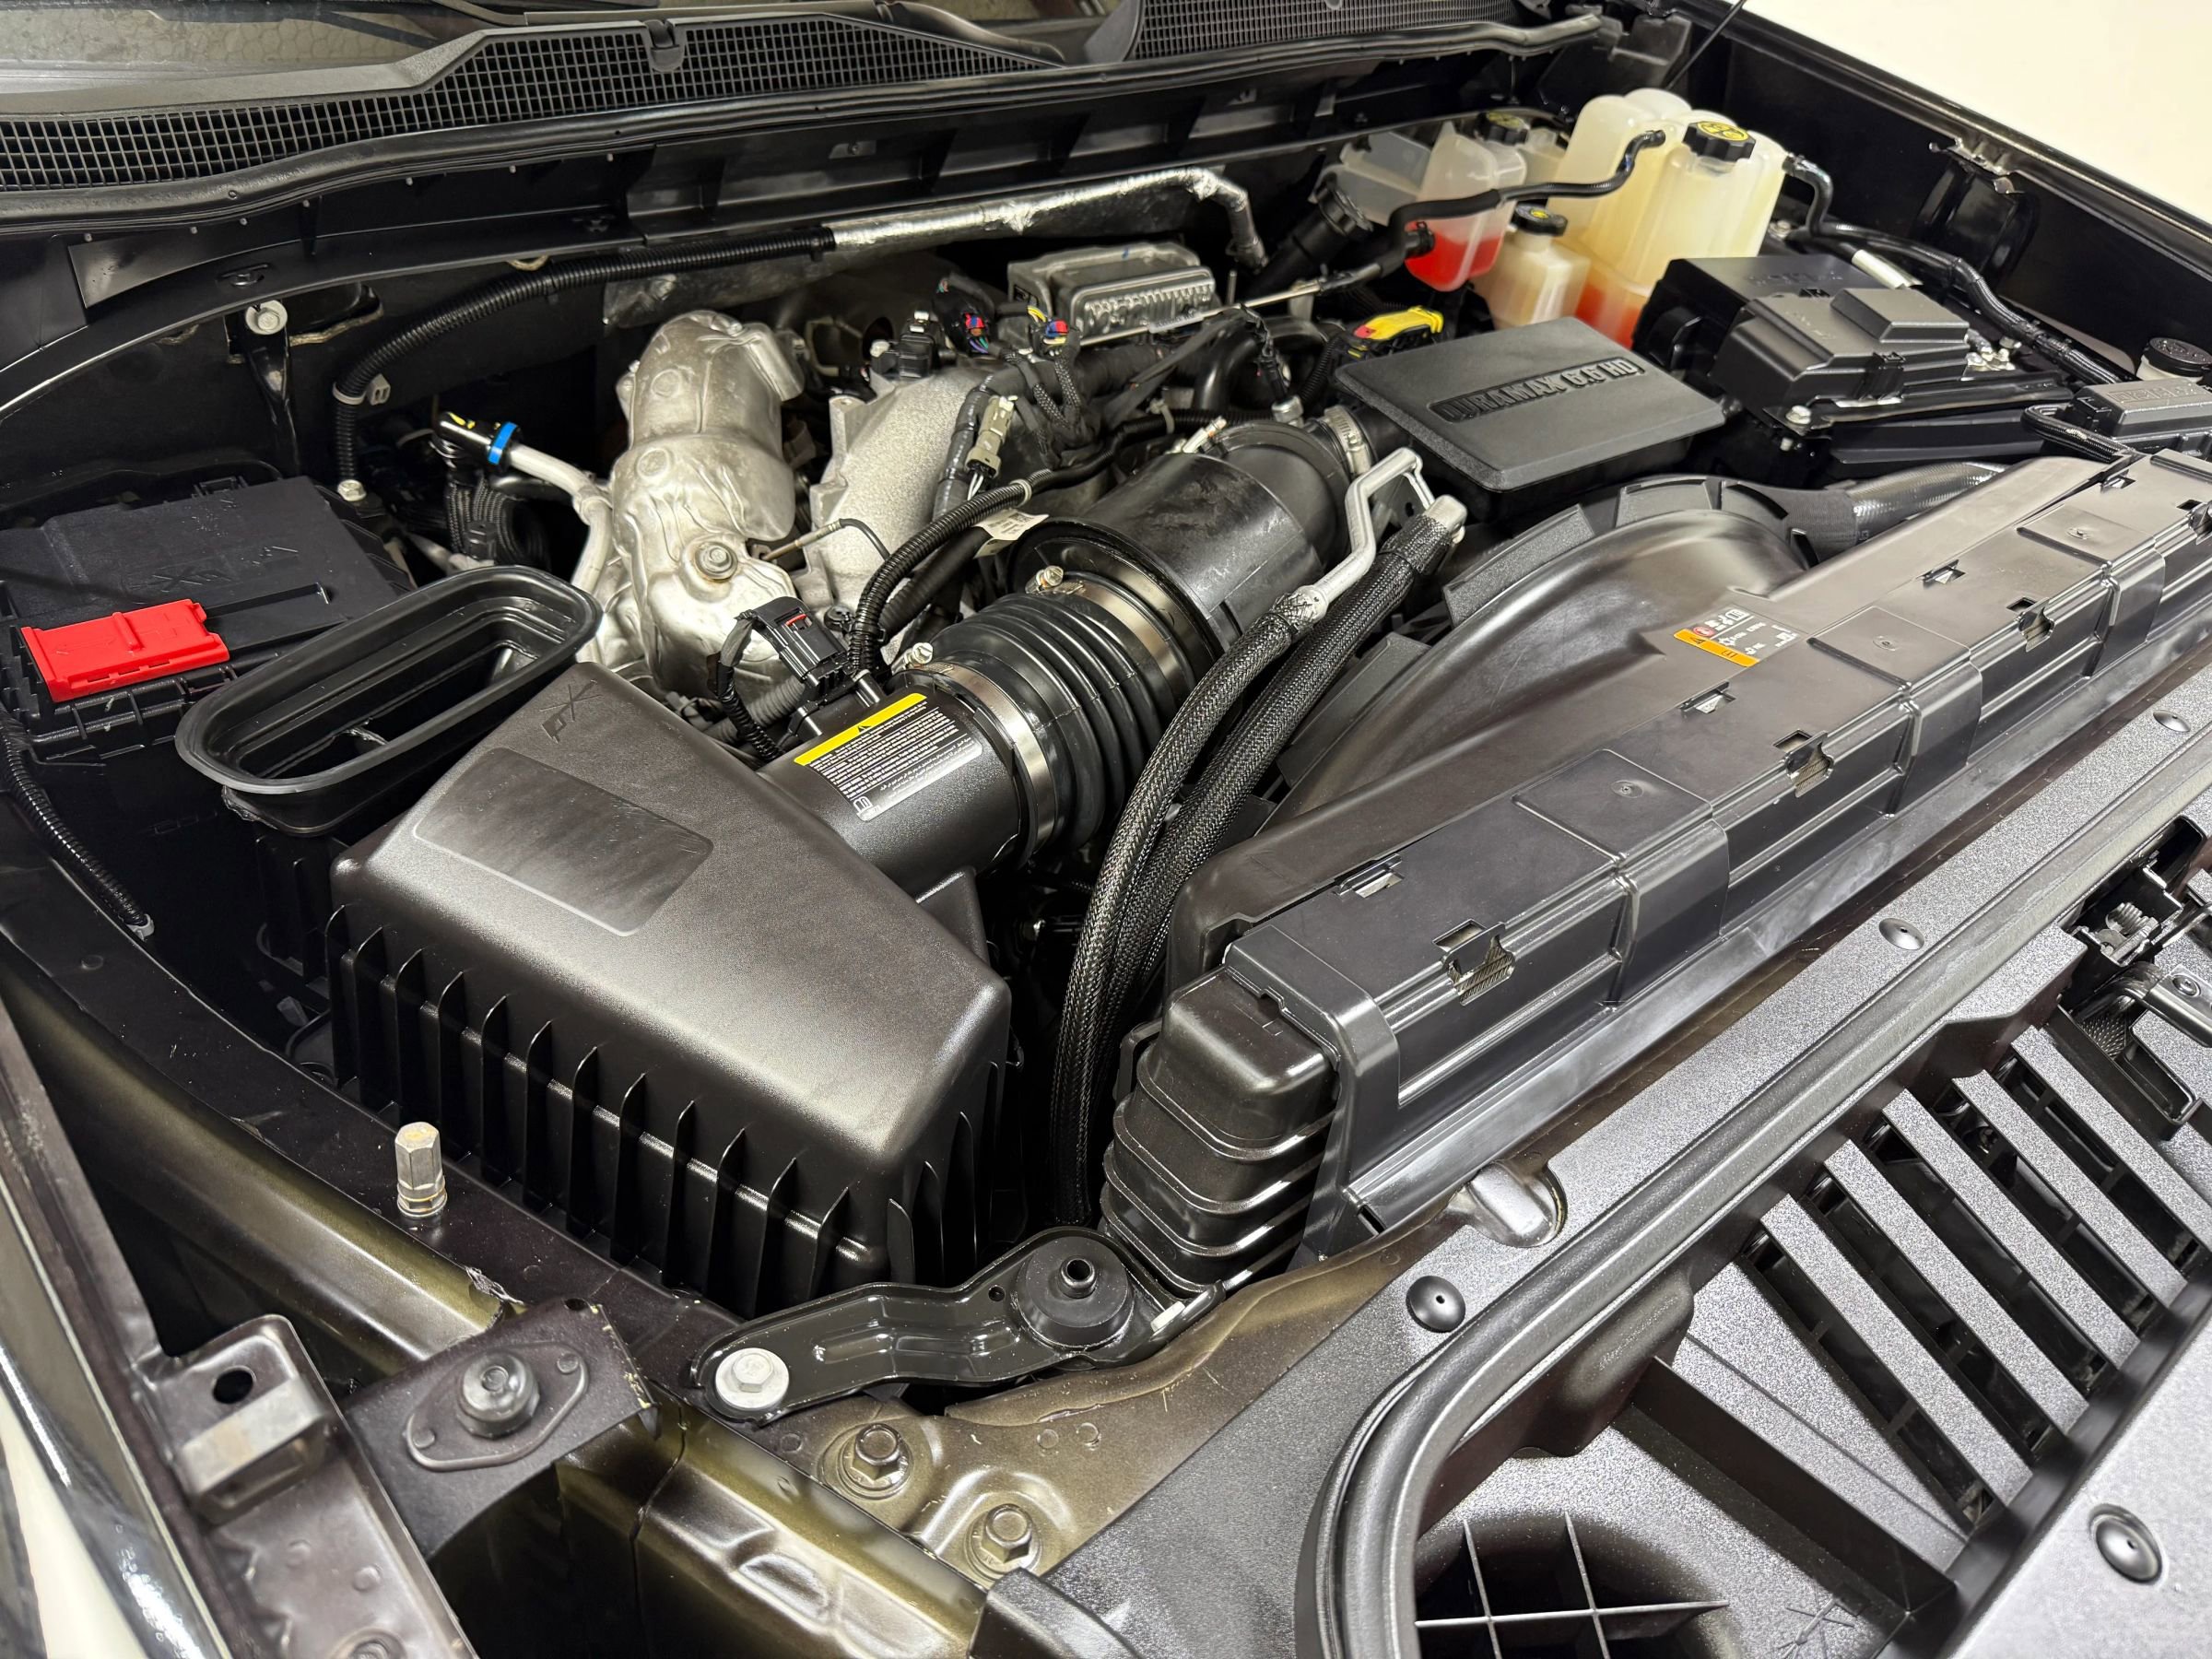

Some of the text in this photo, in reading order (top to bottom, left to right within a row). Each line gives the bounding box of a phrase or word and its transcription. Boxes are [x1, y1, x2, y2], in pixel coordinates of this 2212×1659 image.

[1441, 359, 1638, 419] DURAMAX 6.6 HD
